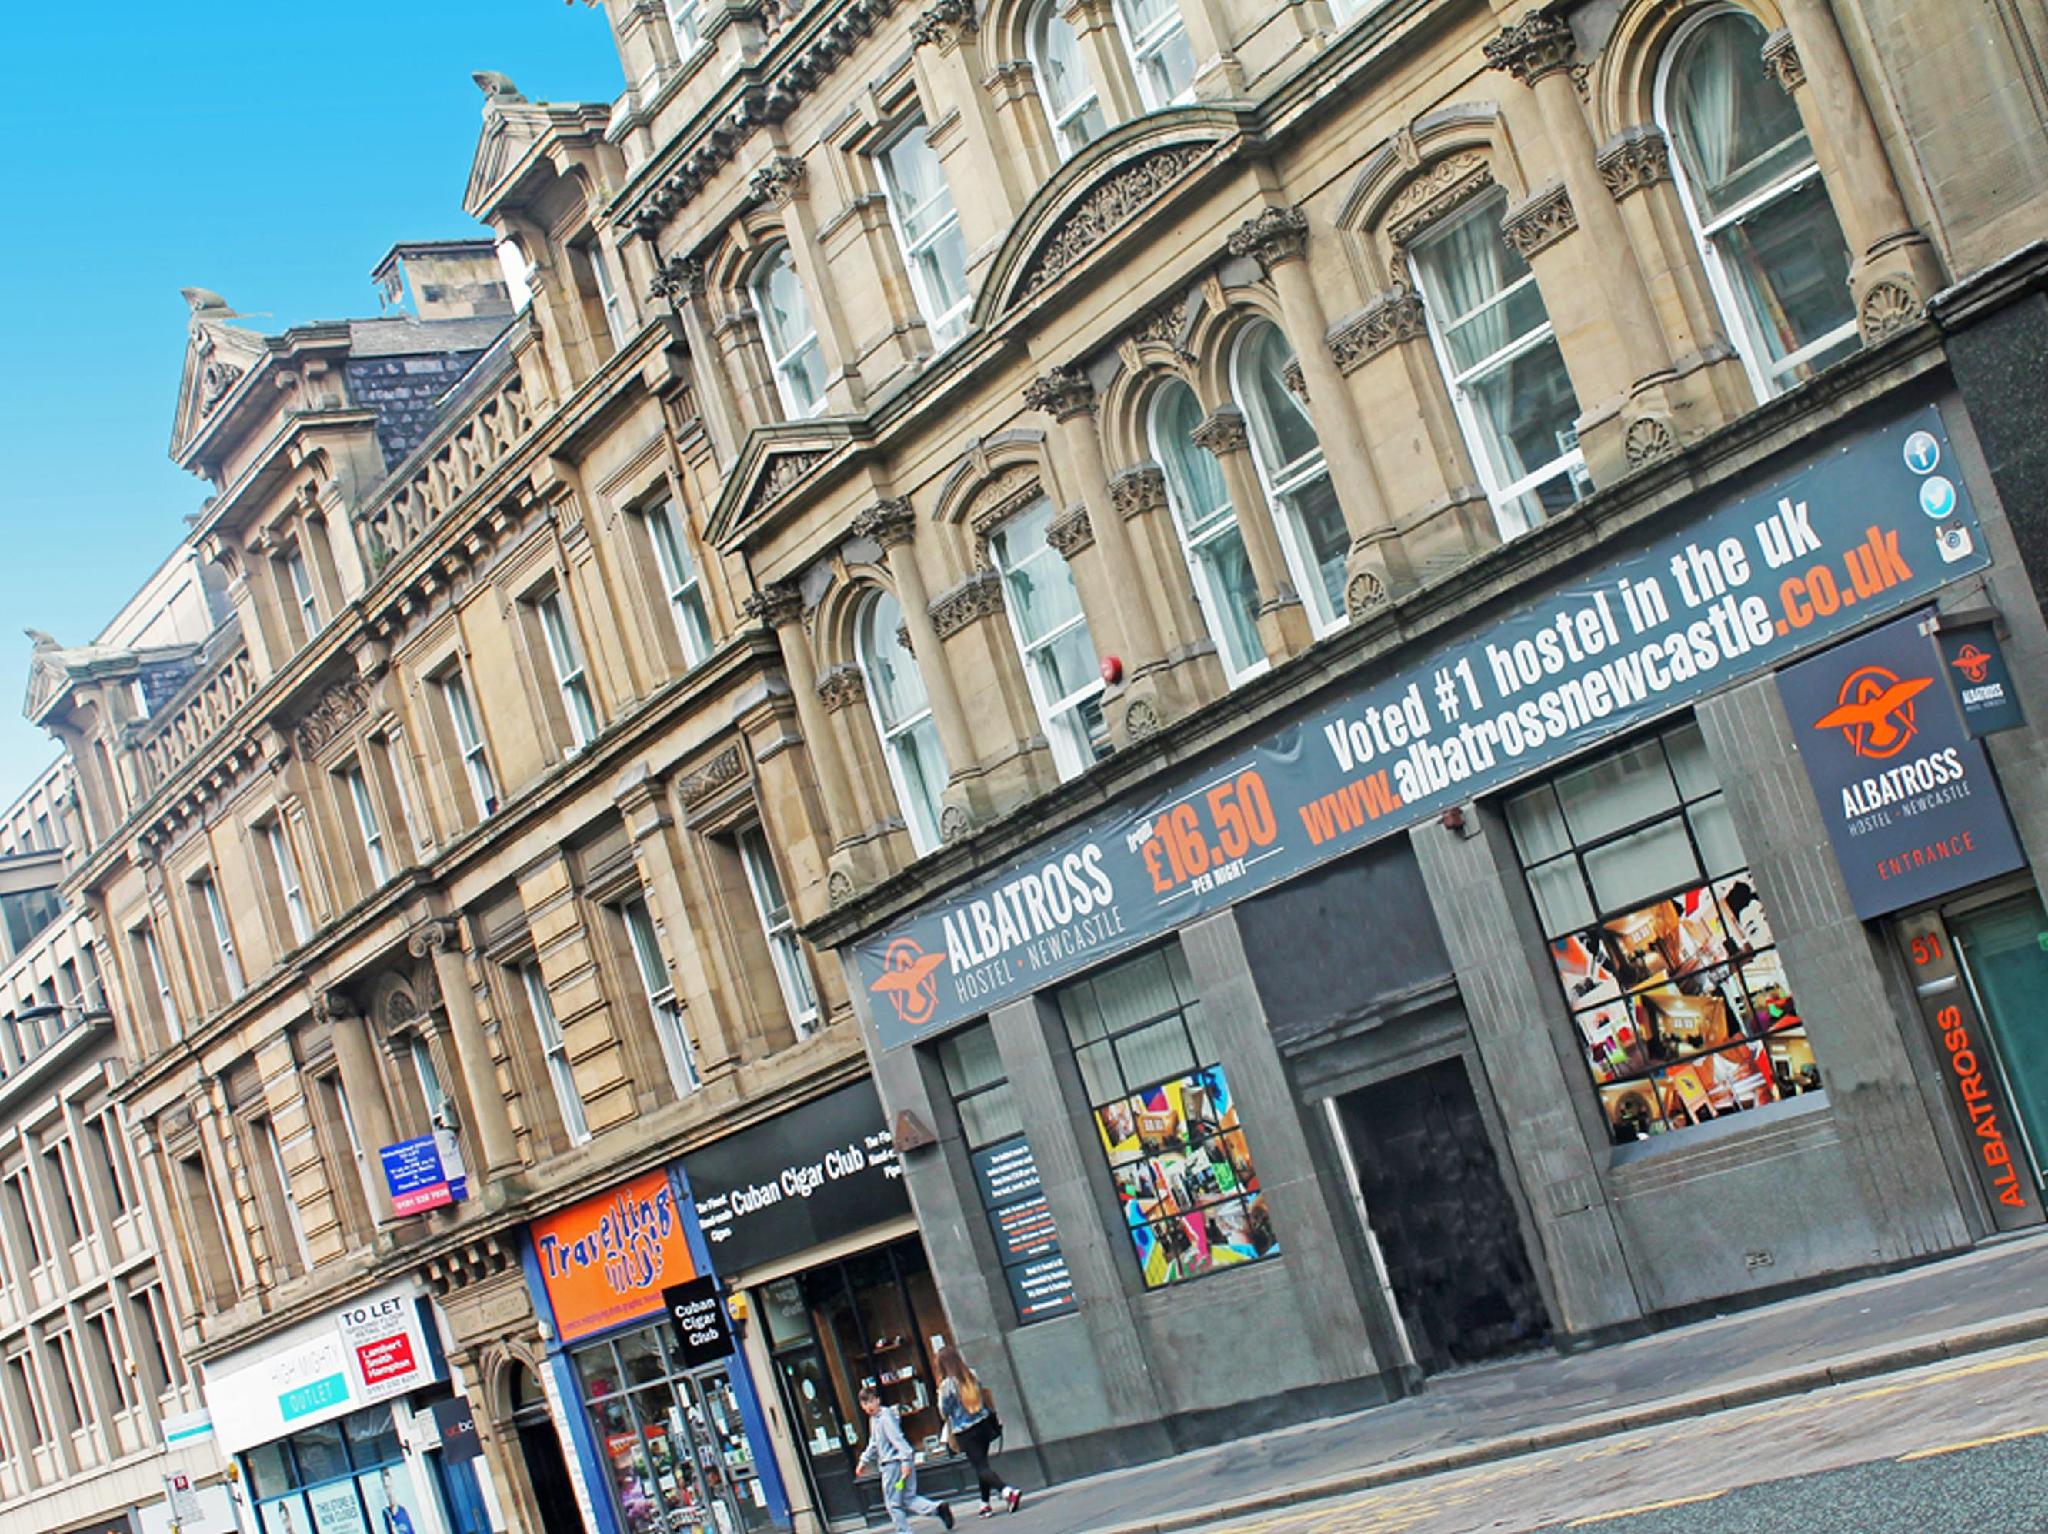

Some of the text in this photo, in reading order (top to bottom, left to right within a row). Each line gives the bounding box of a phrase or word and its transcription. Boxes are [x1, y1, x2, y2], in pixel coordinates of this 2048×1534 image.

[1324, 498, 1823, 772] Voted #1 hostel in the uk
[1299, 524, 1914, 847] www.albatrossnewcastle.co.uk
[1841, 747, 1964, 819] ALBATROSS
[1848, 781, 1972, 838] HOSTEL NEWCASTLE
[1141, 770, 1278, 895] £16.50
[1875, 831, 1976, 881] ENTRANCE
[942, 843, 1114, 975] ALBATROSS
[1192, 858, 1247, 896] PER NIGHT
[955, 906, 1127, 1004] HOSTEL NEWCASTLE
[1910, 932, 1943, 965] 51
[1936, 1005, 2026, 1208] ALBATROSS
[730, 1181, 783, 1217] Cuban
[781, 1162, 826, 1198] Cigar
[825, 1144, 866, 1180] Club
[539, 1186, 672, 1277] Travelling
[342, 1297, 401, 1326] TO LET
[675, 1297, 716, 1318] Cuban
[682, 1312, 716, 1332] Cigar
[689, 1327, 719, 1348] Club
[288, 1382, 333, 1412] OUTLET
